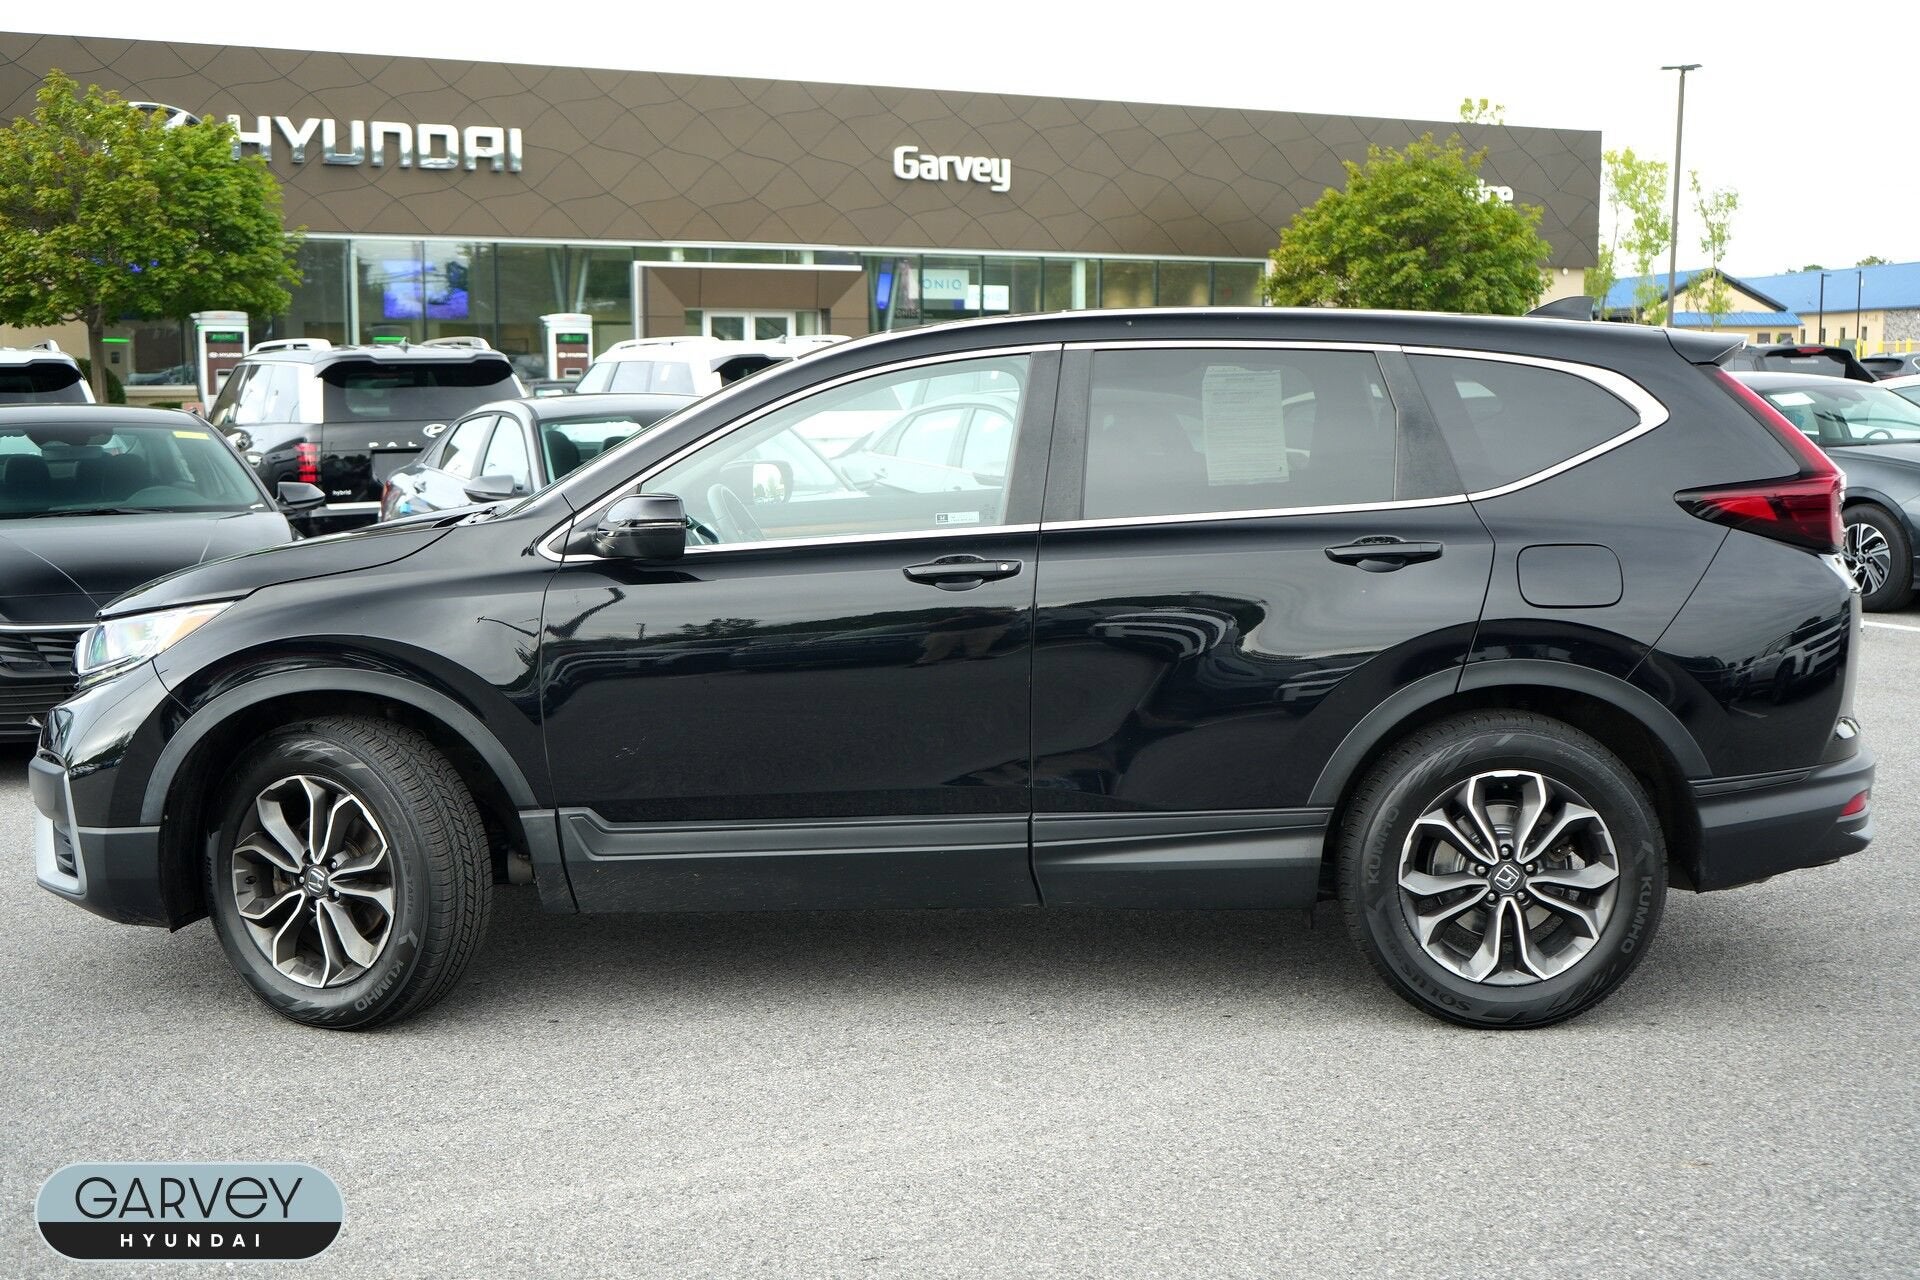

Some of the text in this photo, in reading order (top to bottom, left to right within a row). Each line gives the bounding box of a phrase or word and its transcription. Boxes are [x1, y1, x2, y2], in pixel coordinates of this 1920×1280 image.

[226, 114, 523, 173] HYUNDAI
[893, 145, 1012, 192] Garvey
[332, 489, 352, 497] hybrid
[1367, 806, 1399, 884] KUMHO
[1620, 876, 1653, 954] KUMHO
[354, 960, 405, 1012] KUMHO
